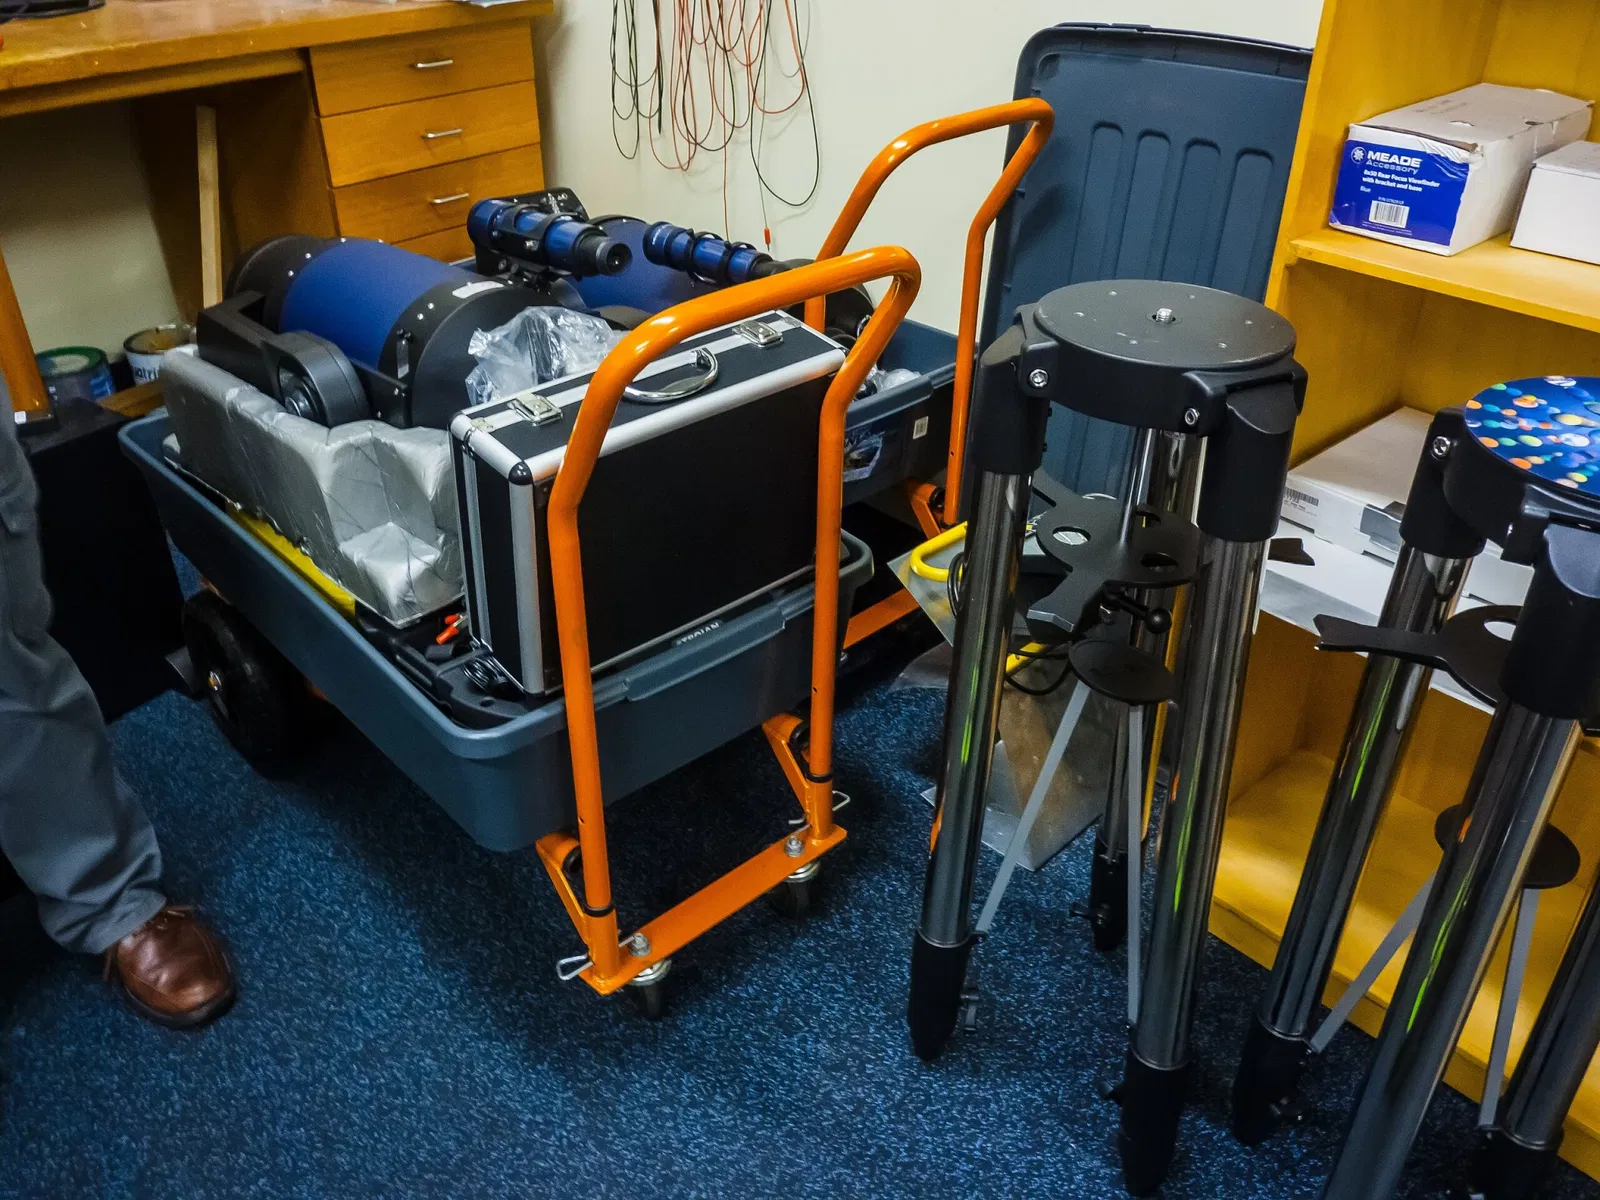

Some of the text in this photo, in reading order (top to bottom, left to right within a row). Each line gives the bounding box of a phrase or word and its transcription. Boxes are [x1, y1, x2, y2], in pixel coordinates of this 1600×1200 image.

[1366, 159, 1419, 175] Accessory
[1367, 150, 1423, 168] MEADE
[1362, 176, 1375, 184] with
[1375, 178, 1396, 188] bracket
[1408, 184, 1423, 192] base
[1391, 173, 1408, 182] Focus
